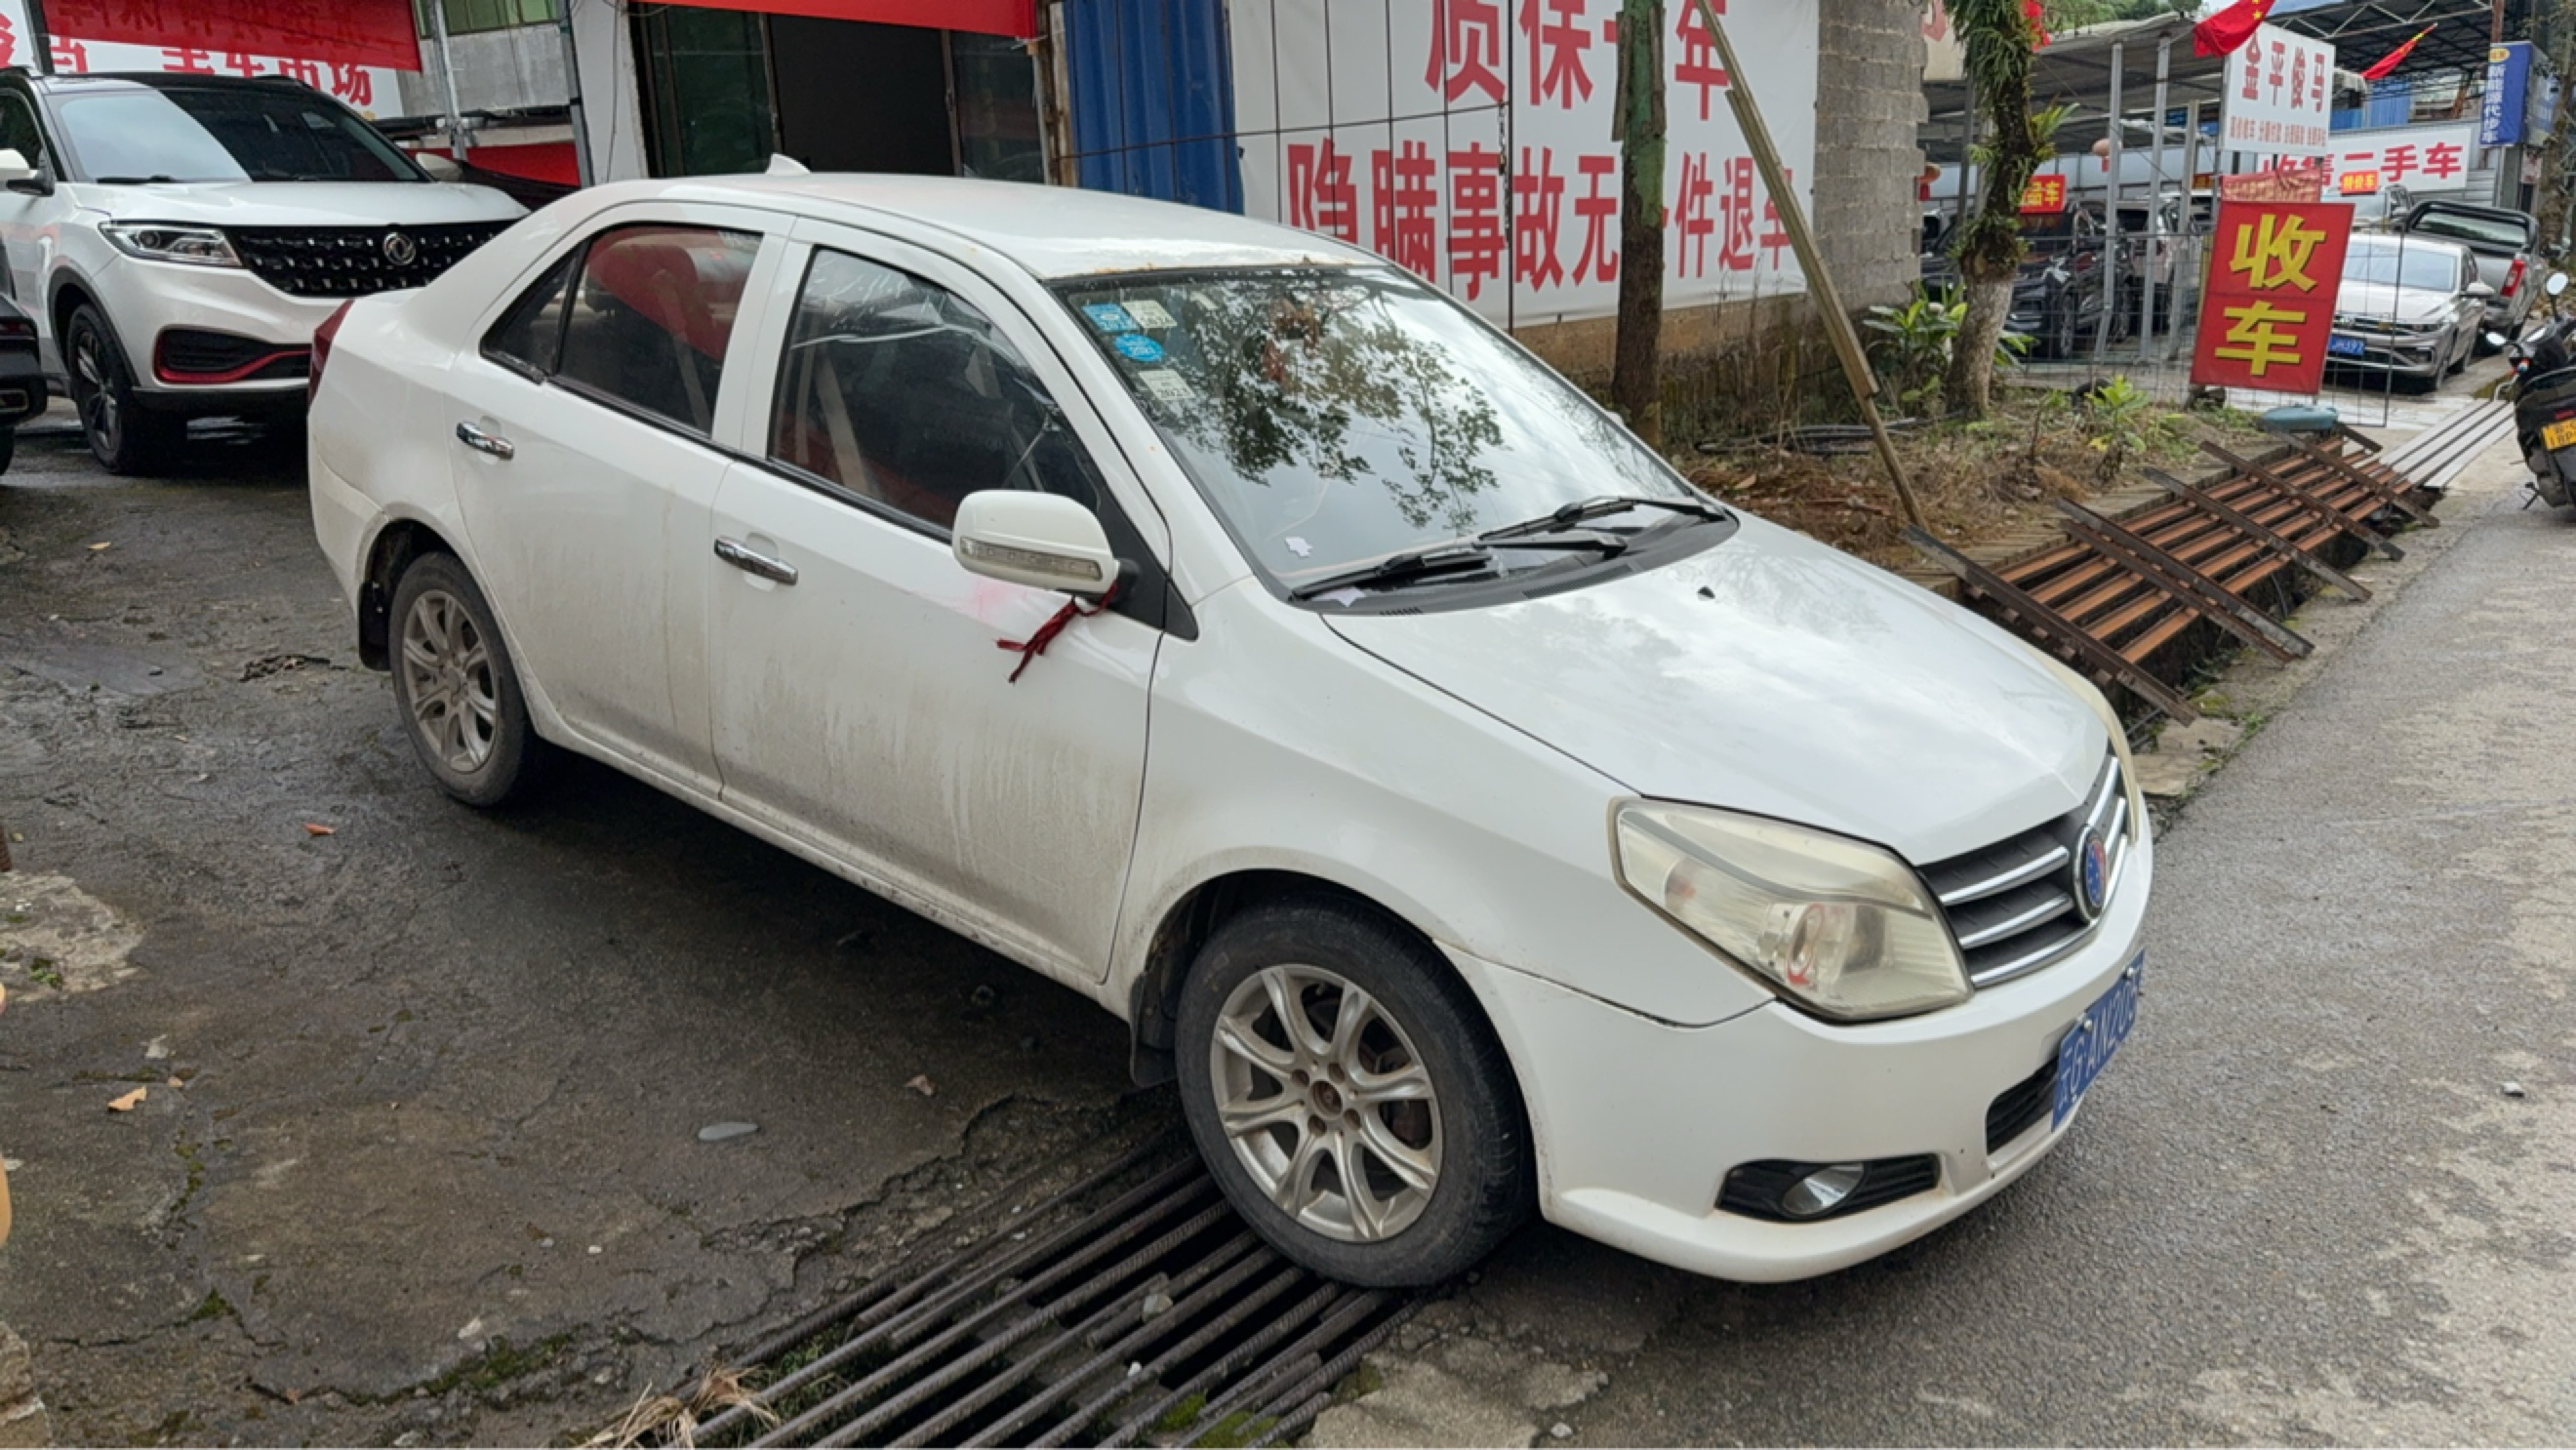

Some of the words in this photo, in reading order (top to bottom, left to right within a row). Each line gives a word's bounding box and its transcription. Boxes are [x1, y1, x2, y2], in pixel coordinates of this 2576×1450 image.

[1424, 0, 1729, 121] 质保年
[1286, 136, 1793, 302] 隐瞒事故无件退车
[2214, 214, 2327, 377] 收车
